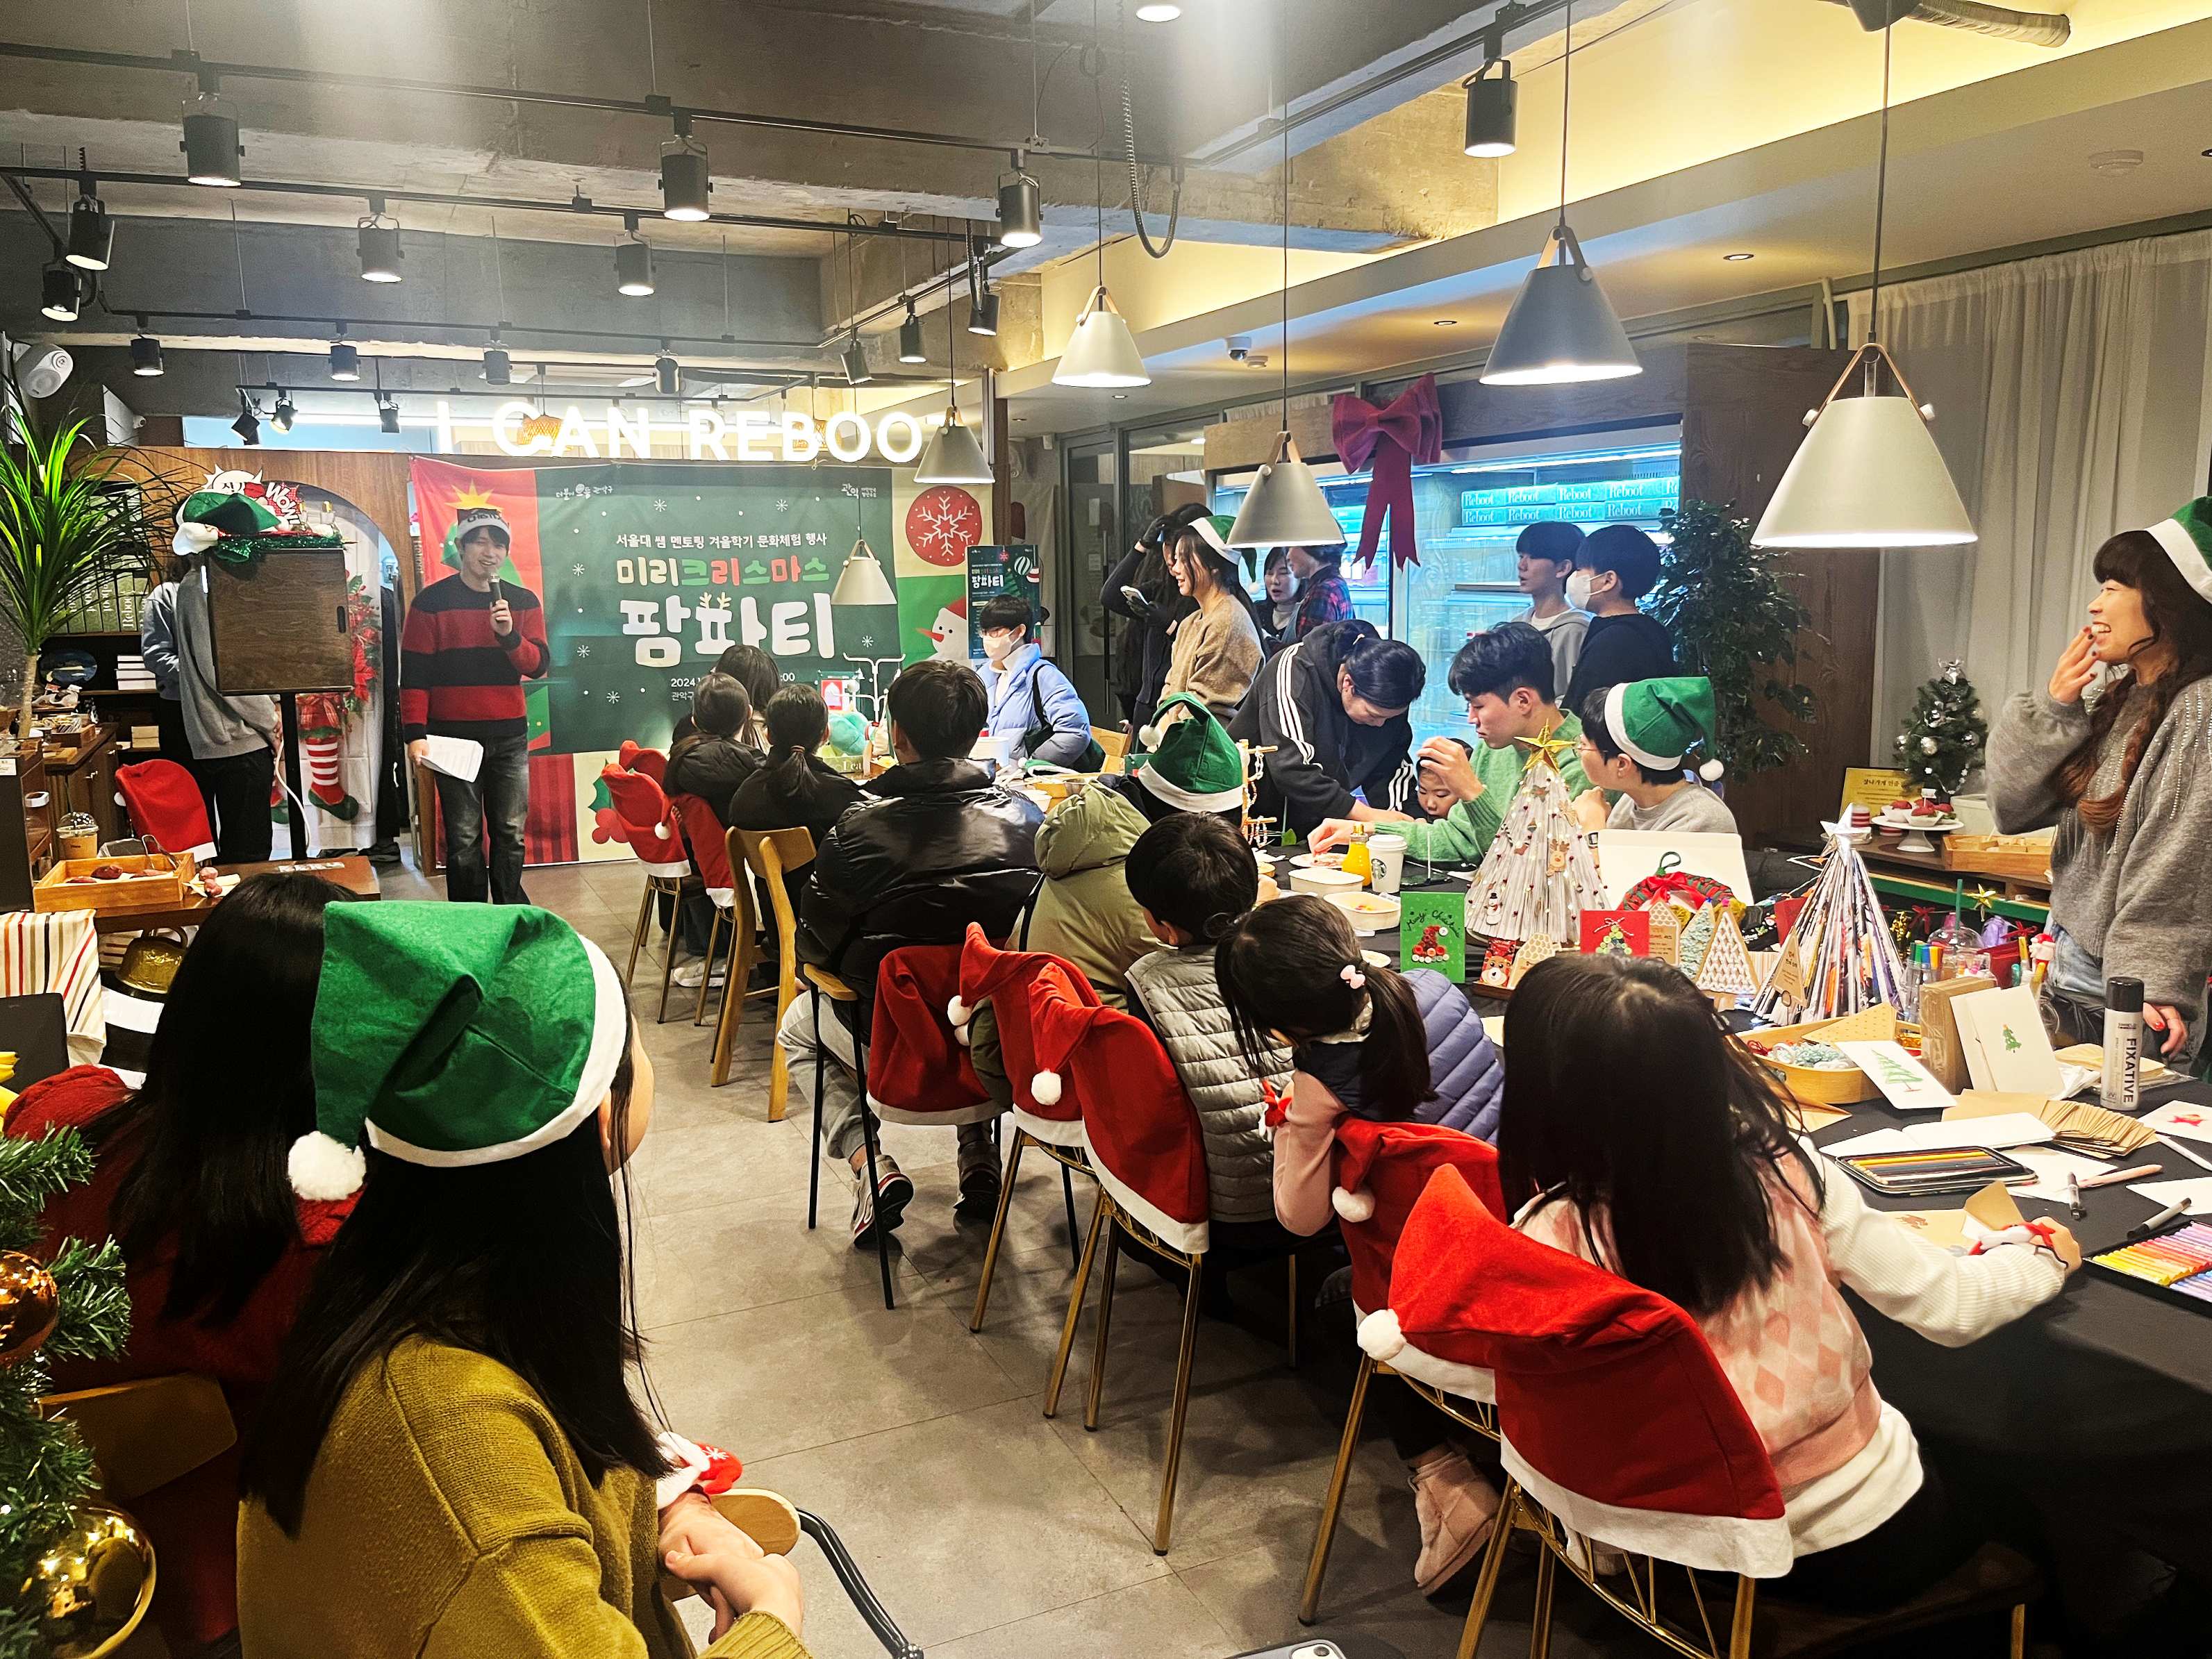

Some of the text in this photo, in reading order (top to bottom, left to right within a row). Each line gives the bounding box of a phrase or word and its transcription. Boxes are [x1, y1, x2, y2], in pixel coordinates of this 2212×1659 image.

[437, 401, 953, 463] I CAN REBOO
[1508, 490, 1539, 503] Reboot
[1559, 487, 1591, 501] Reboot
[1465, 510, 1494, 523] Reboot
[1508, 508, 1540, 521] Reboot
[1558, 505, 1592, 519] Reboot
[1608, 503, 1642, 517] Reboot
[616, 534, 651, 548] 서울대
[670, 535, 704, 549] 멘토링
[709, 535, 754, 549] 겨울학기
[757, 534, 801, 547] 문화체험
[805, 533, 827, 547] 행사
[972, 575, 1004, 589] 팡파티
[620, 592, 835, 668] 팡파티
[2123, 1038, 2137, 1103] FIXATIVE
